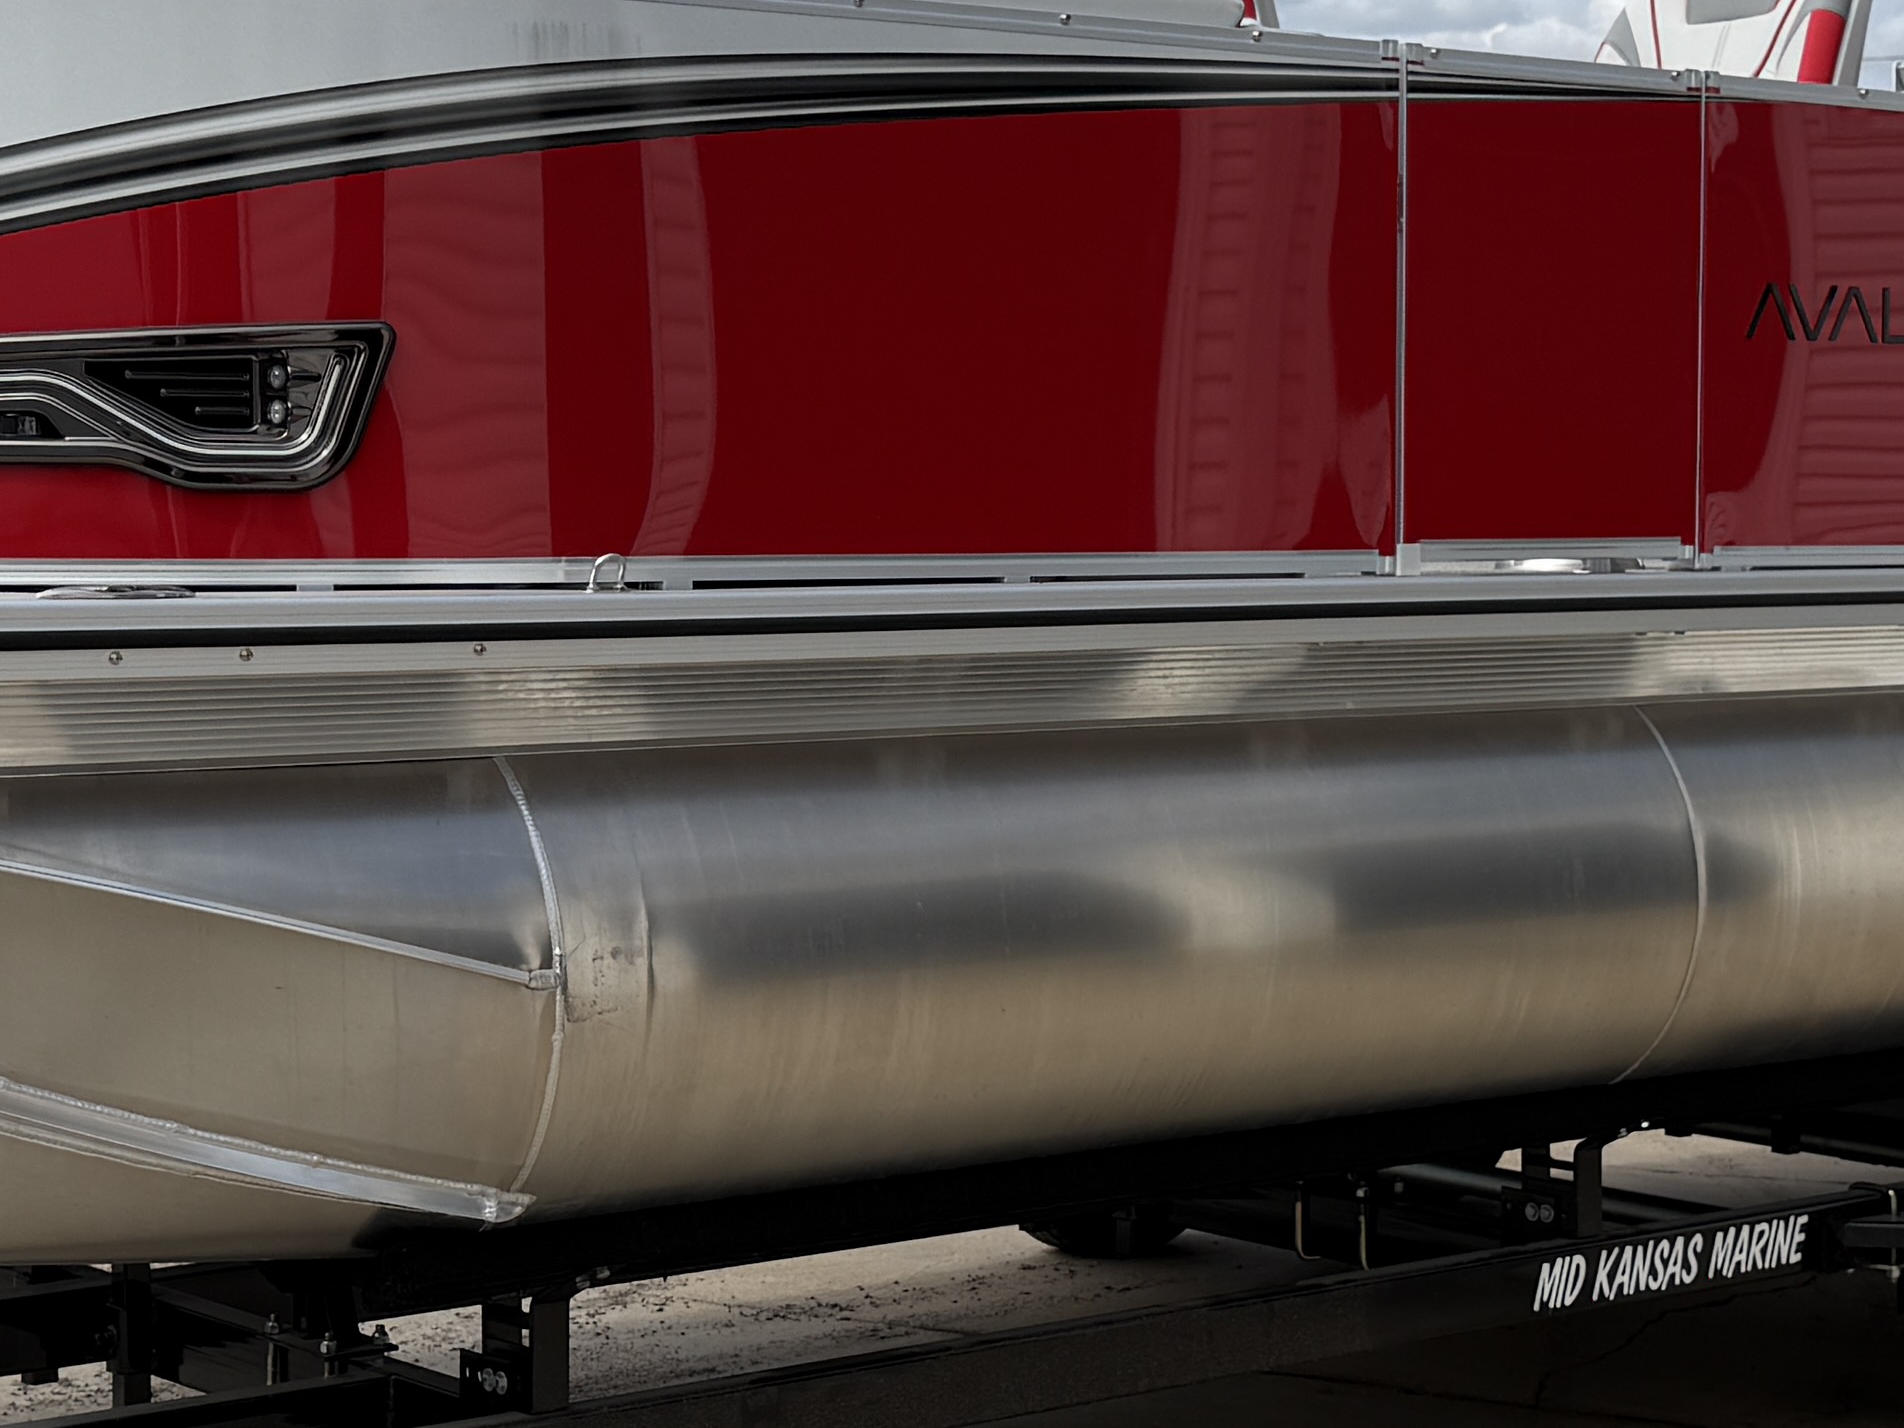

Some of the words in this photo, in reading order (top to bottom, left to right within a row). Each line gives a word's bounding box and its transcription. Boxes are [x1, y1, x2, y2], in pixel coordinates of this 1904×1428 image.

[1533, 1253, 1586, 1312] MID
[1592, 1232, 1703, 1302] KANSAS
[1708, 1214, 1809, 1280] MARINE
